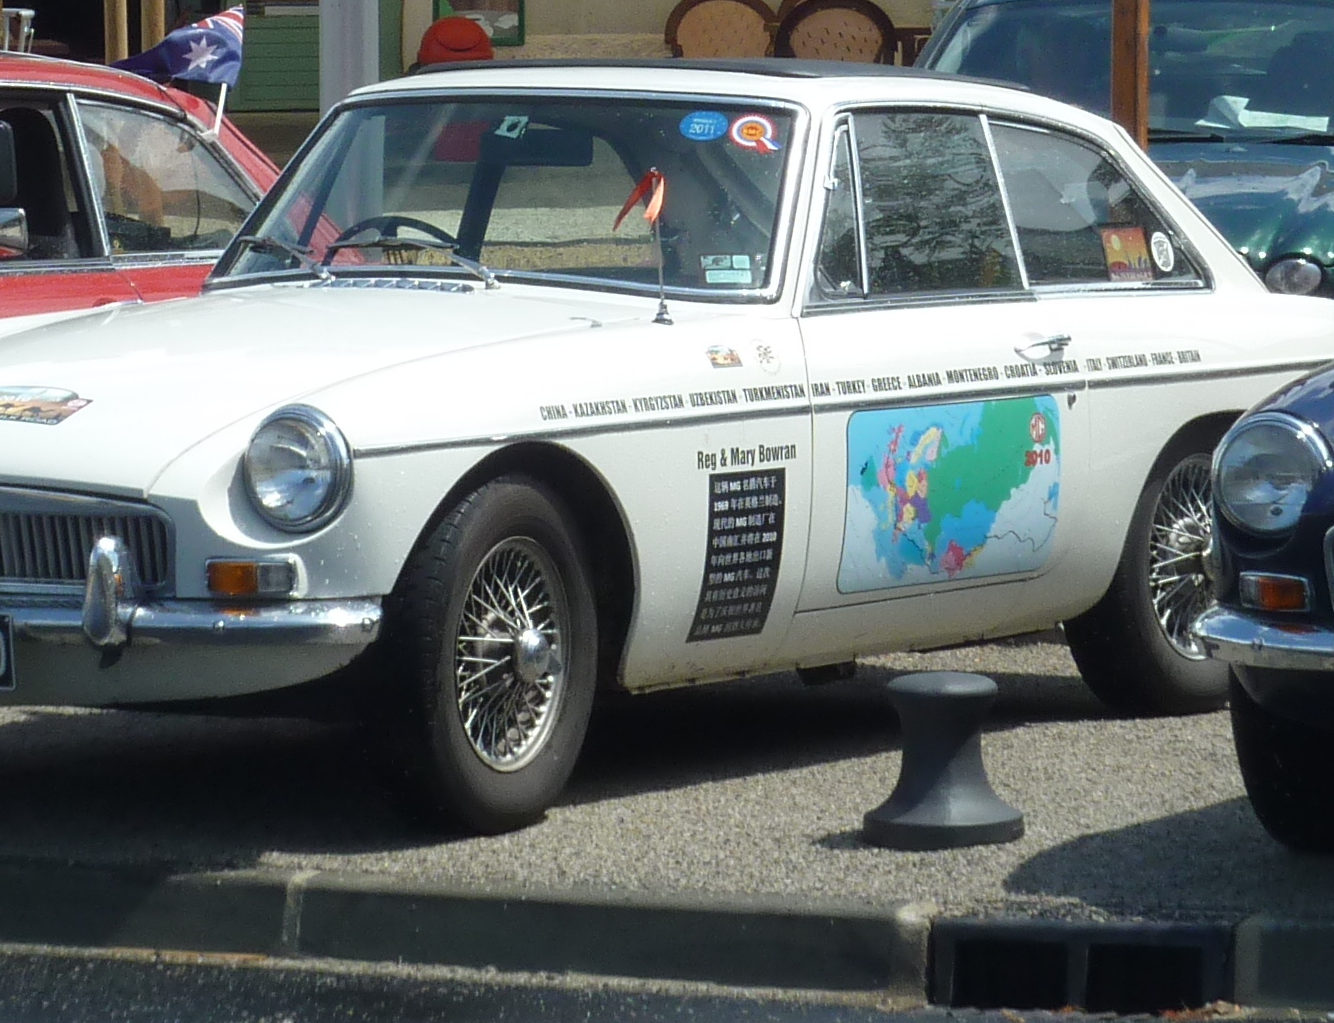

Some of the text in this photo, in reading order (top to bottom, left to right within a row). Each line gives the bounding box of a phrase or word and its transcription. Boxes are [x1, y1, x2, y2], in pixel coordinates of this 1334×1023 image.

[689, 123, 715, 134] 2011
[540, 349, 1202, 421] CHINA KAZAKHSTAN KYRGYZSTAN UZBEKISTAN TURKMENISTAN IRAN TURKEY GREECE ALBANIA MONTENEGRO CROATIA SLOVENIA ITALY SWITZERLAND FRANCE BRITAIN
[697, 444, 796, 470] Reg & Mary Bowran
